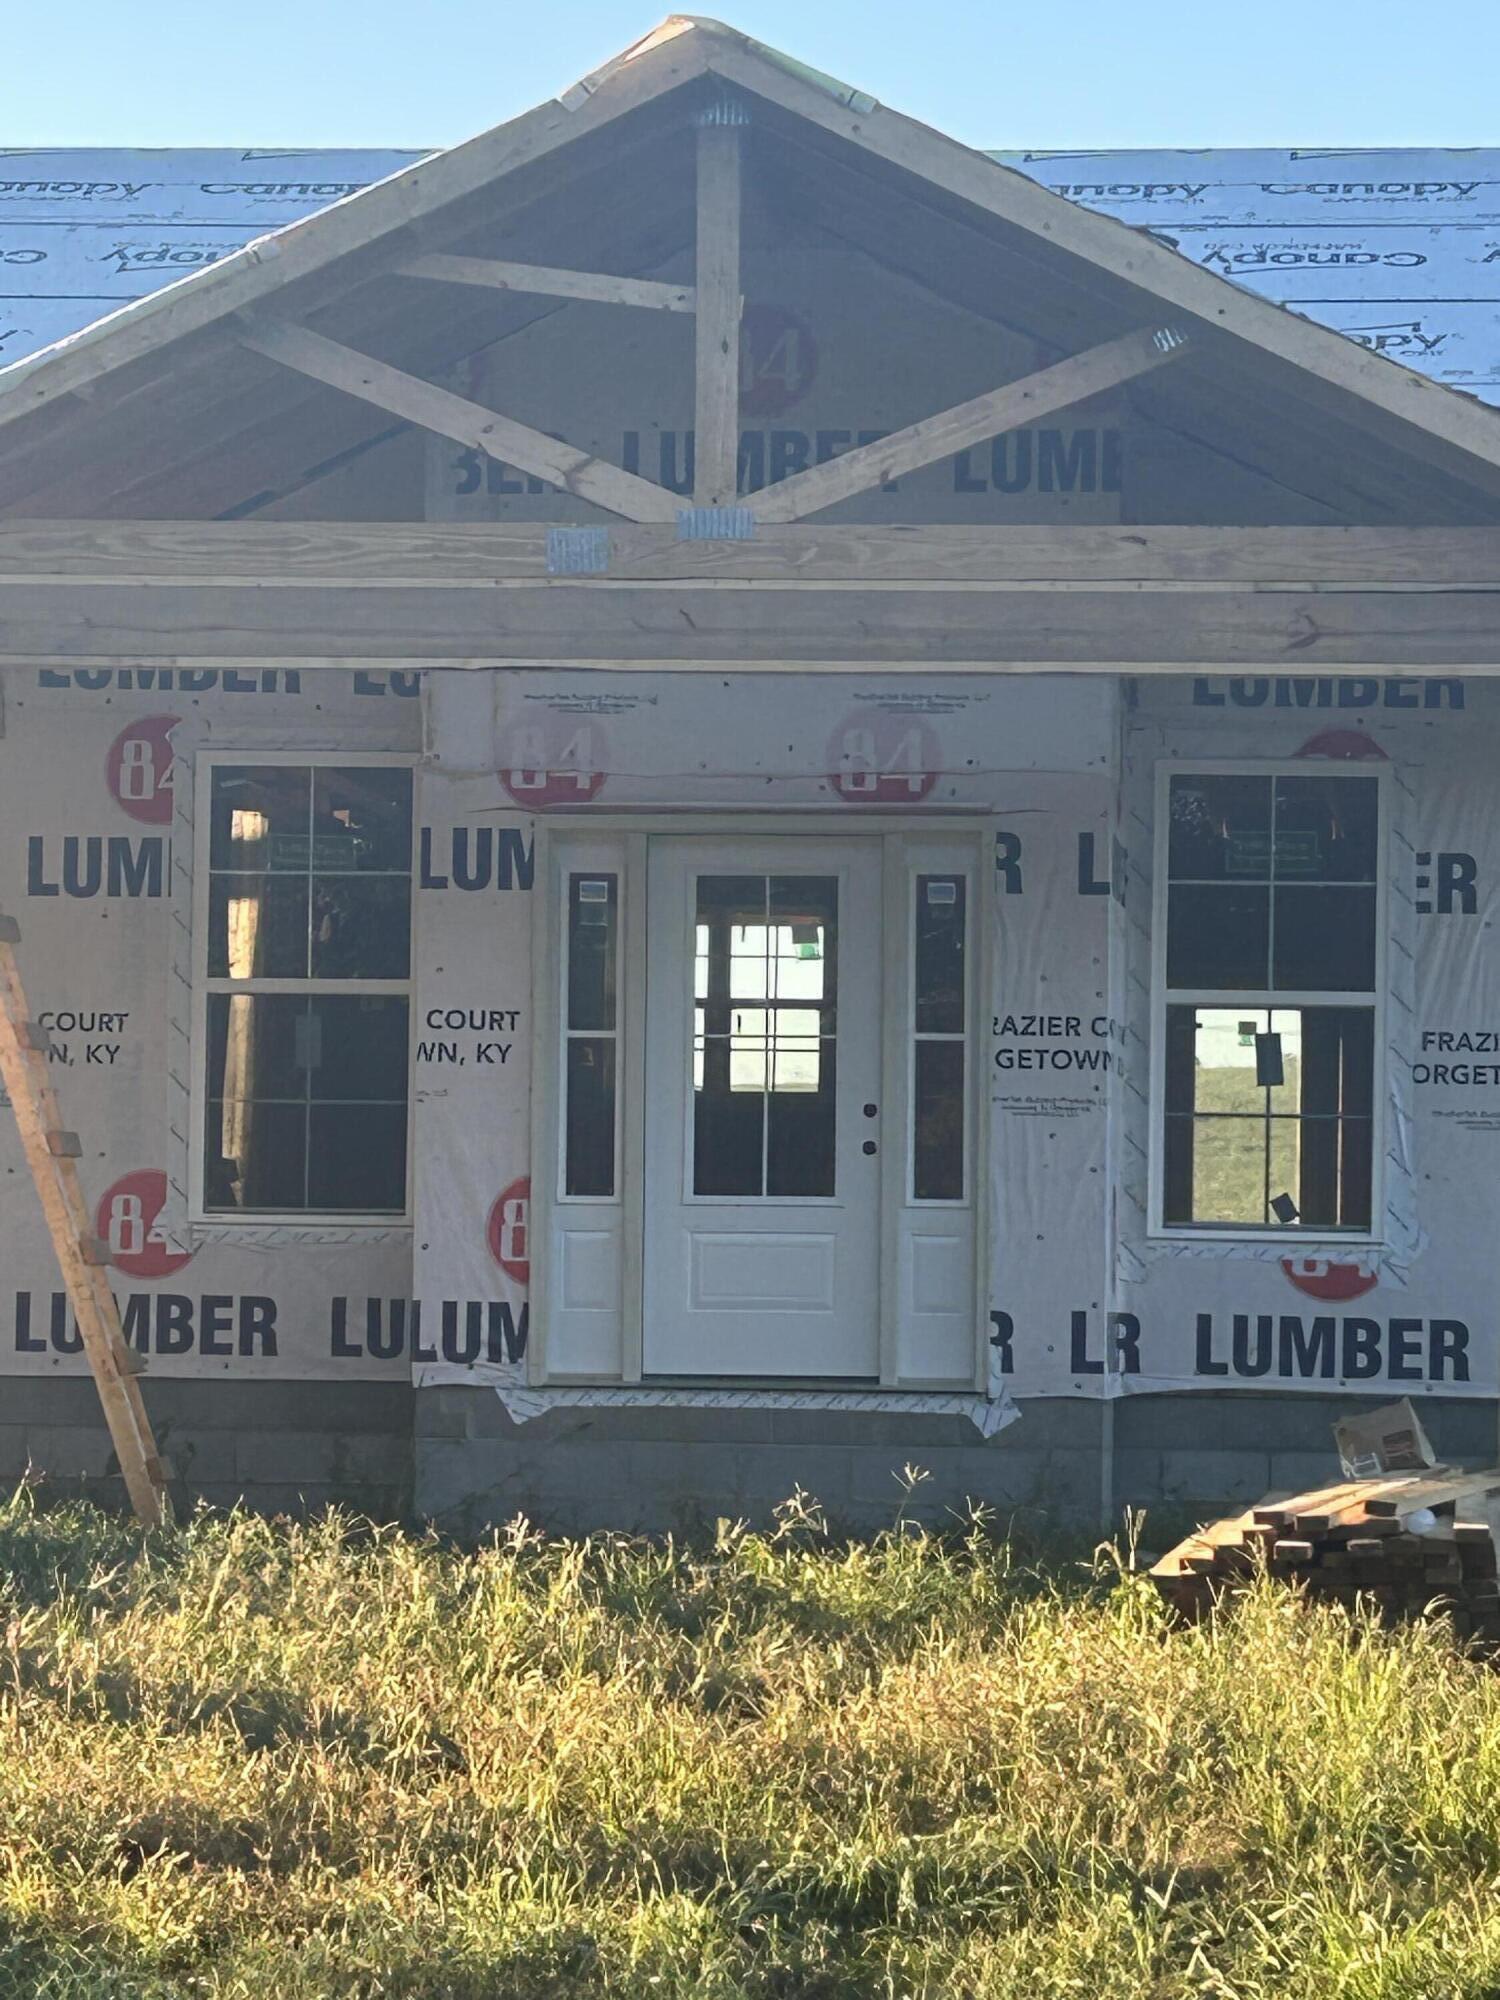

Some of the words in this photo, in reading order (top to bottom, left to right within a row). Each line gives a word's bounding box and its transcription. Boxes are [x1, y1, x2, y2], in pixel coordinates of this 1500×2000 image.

[1202, 249, 1427, 267] Canopy
[840, 728, 927, 792] 84
[27, 836, 172, 899] LUM
[37, 1011, 129, 1033] COURT
[426, 1009, 521, 1032] COURT
[86, 1043, 121, 1064] KY
[476, 1043, 513, 1064] KY
[15, 1291, 279, 1357] LUMBER
[1195, 1313, 1471, 1382] LUMBER
